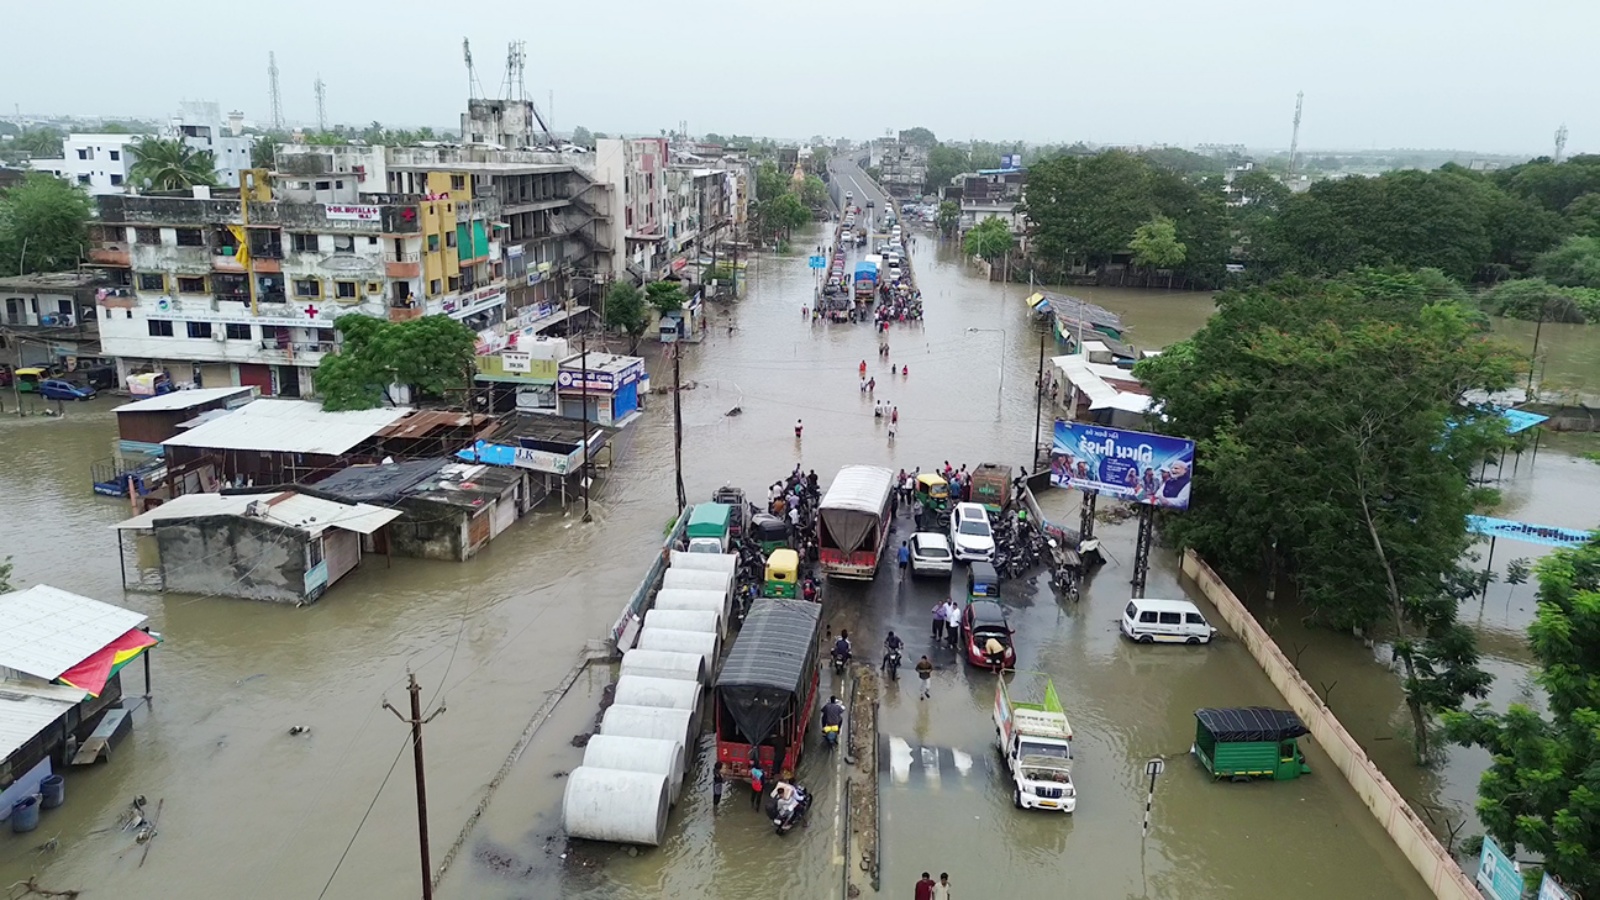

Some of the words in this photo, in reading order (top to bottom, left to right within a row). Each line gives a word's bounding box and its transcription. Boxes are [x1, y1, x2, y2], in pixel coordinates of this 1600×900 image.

[1079, 435, 1115, 457] દેશની
[1116, 443, 1153, 463] પ્રગતિ
[1058, 474, 1071, 485] 12
